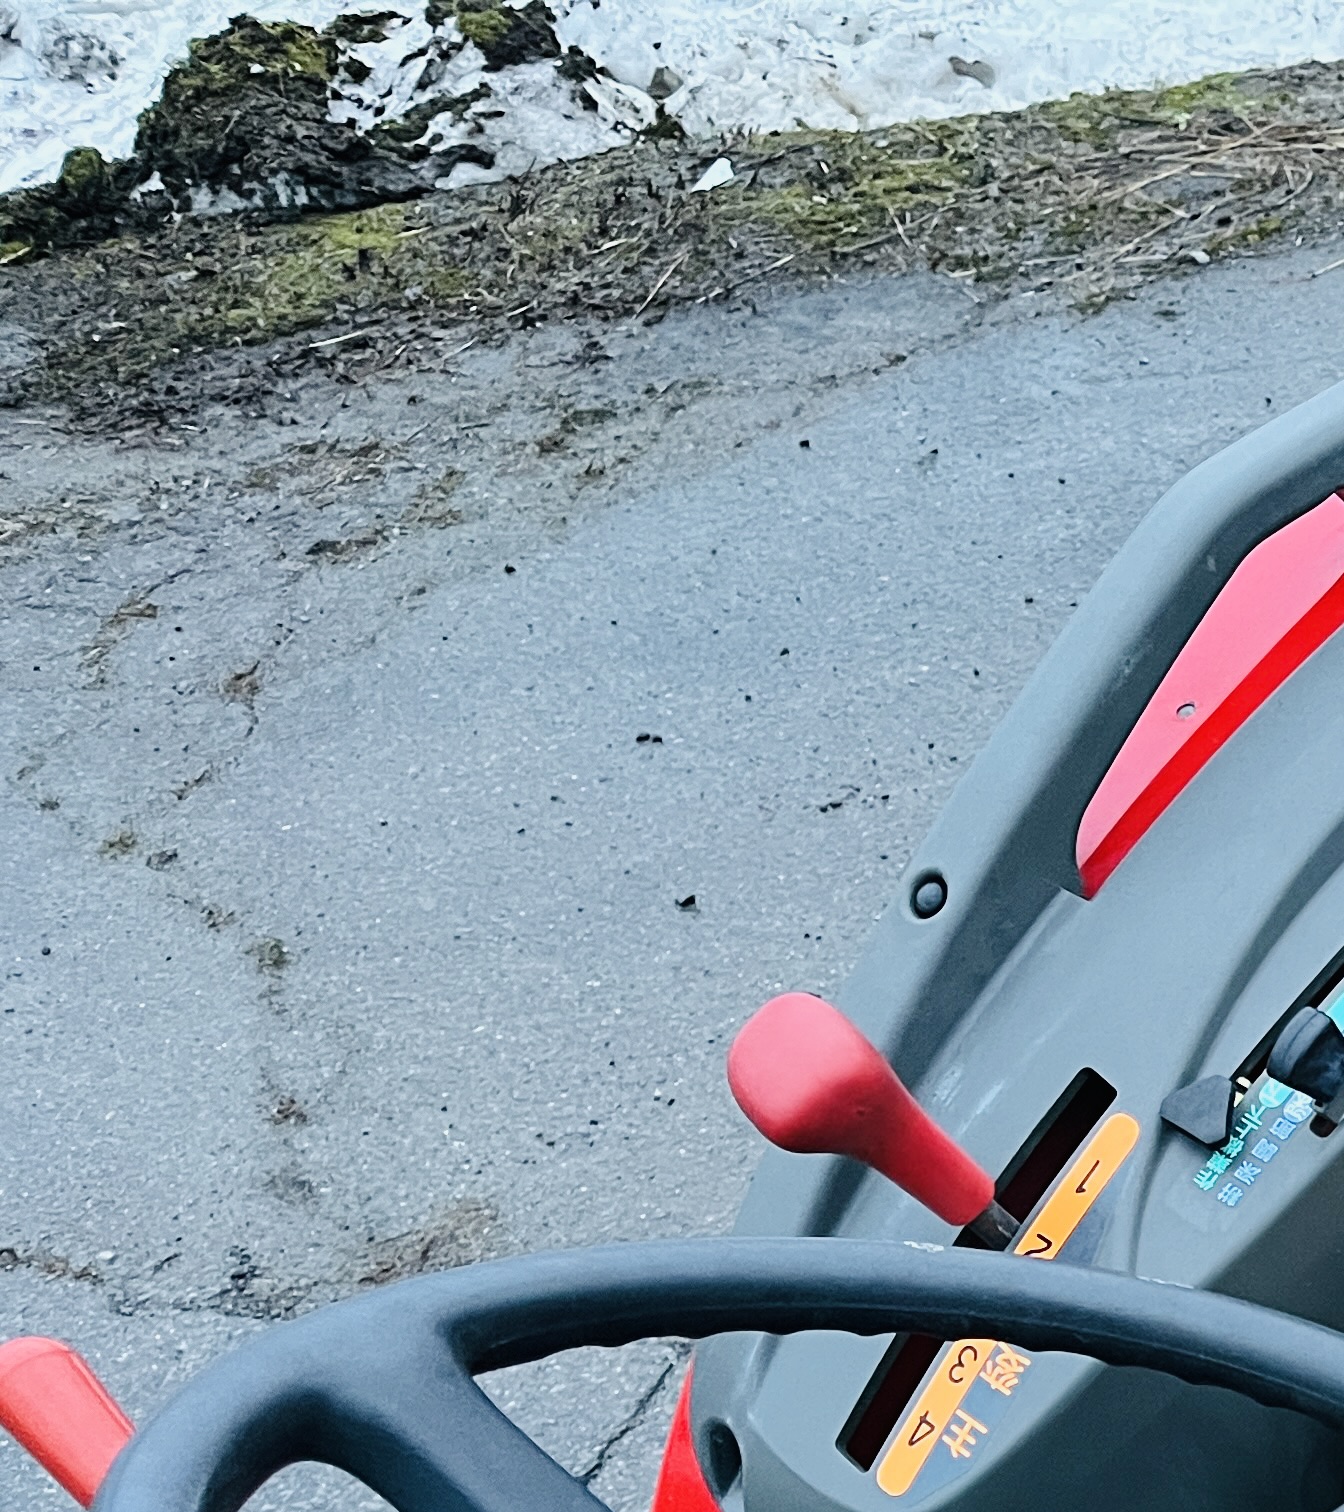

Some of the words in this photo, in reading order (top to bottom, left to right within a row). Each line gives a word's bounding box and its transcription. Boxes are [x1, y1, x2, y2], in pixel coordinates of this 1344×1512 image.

[1076, 1160, 1100, 1194] 1
[949, 1345, 978, 1384] 3
[908, 1410, 935, 1446] 4
